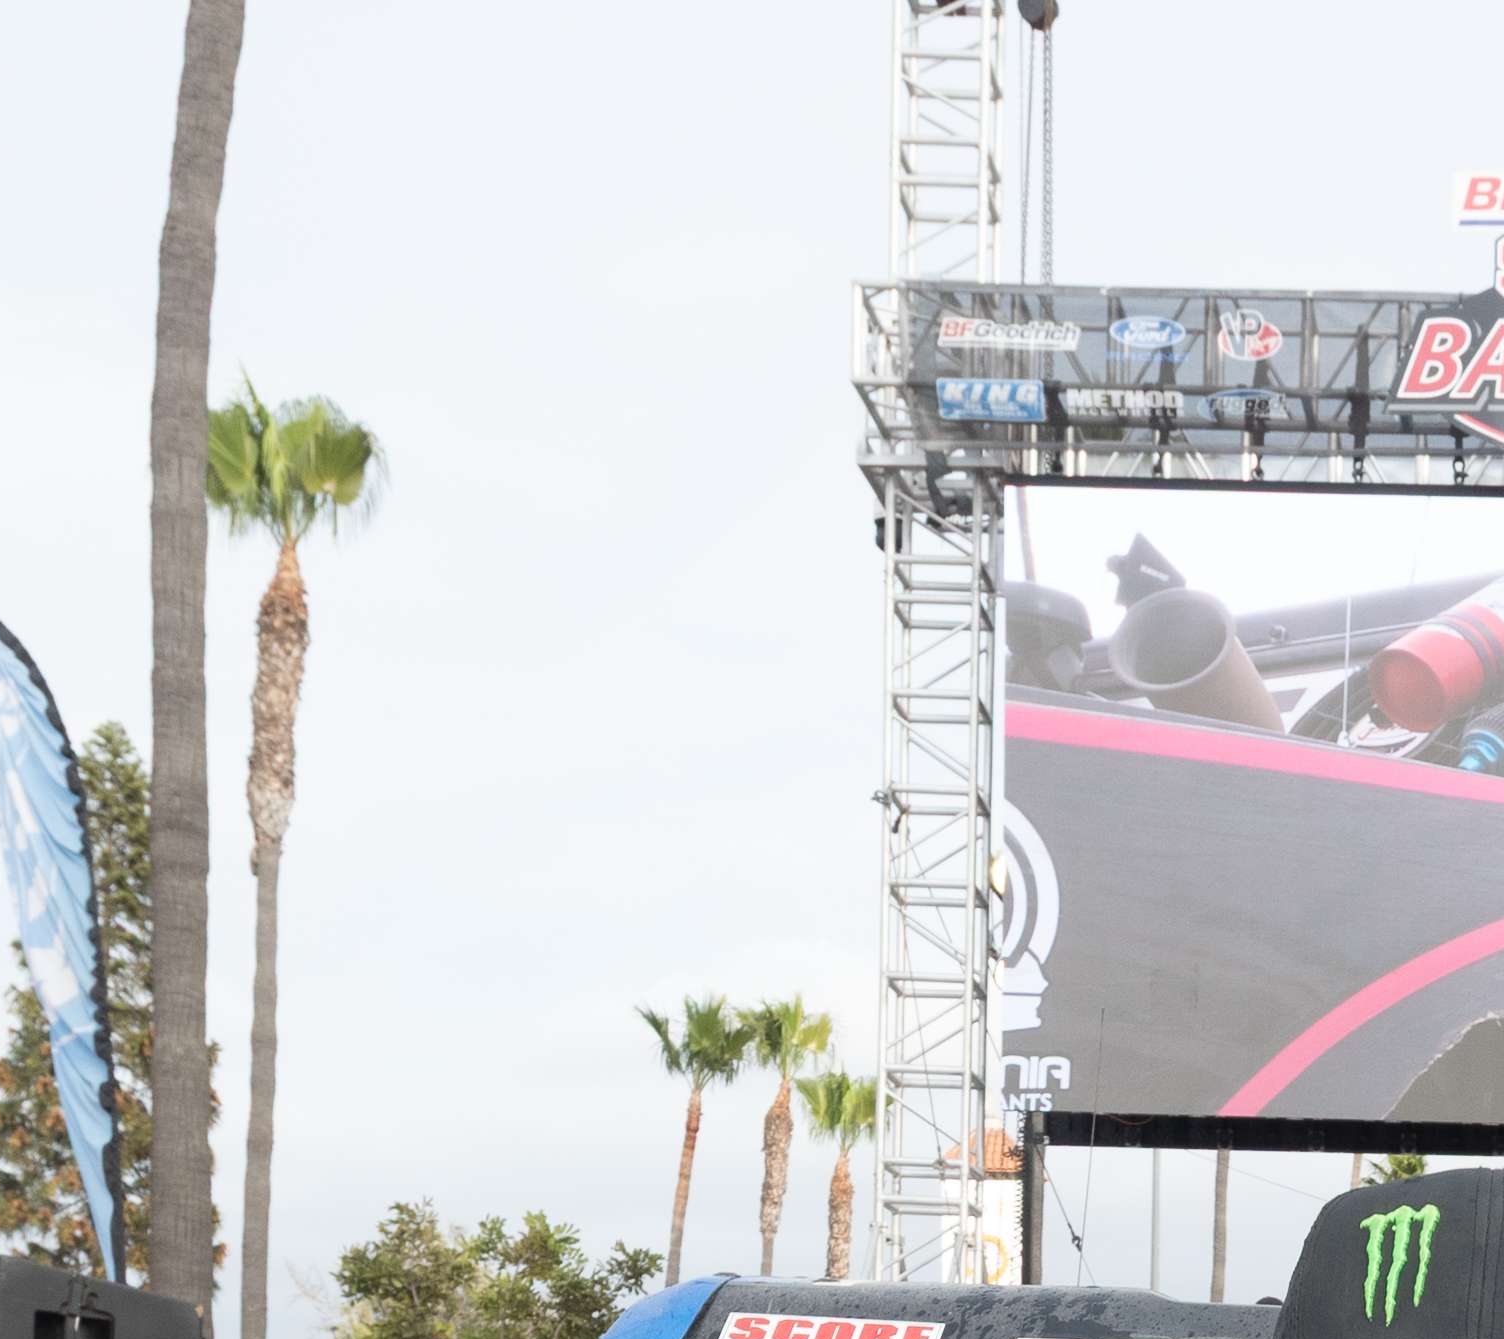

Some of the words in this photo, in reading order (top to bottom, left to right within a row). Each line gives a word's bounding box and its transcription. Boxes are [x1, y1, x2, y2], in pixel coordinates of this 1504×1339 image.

[941, 319, 1081, 344] BFGoodrich
[944, 382, 1039, 403] KING
[1067, 388, 1185, 409] METHOD
